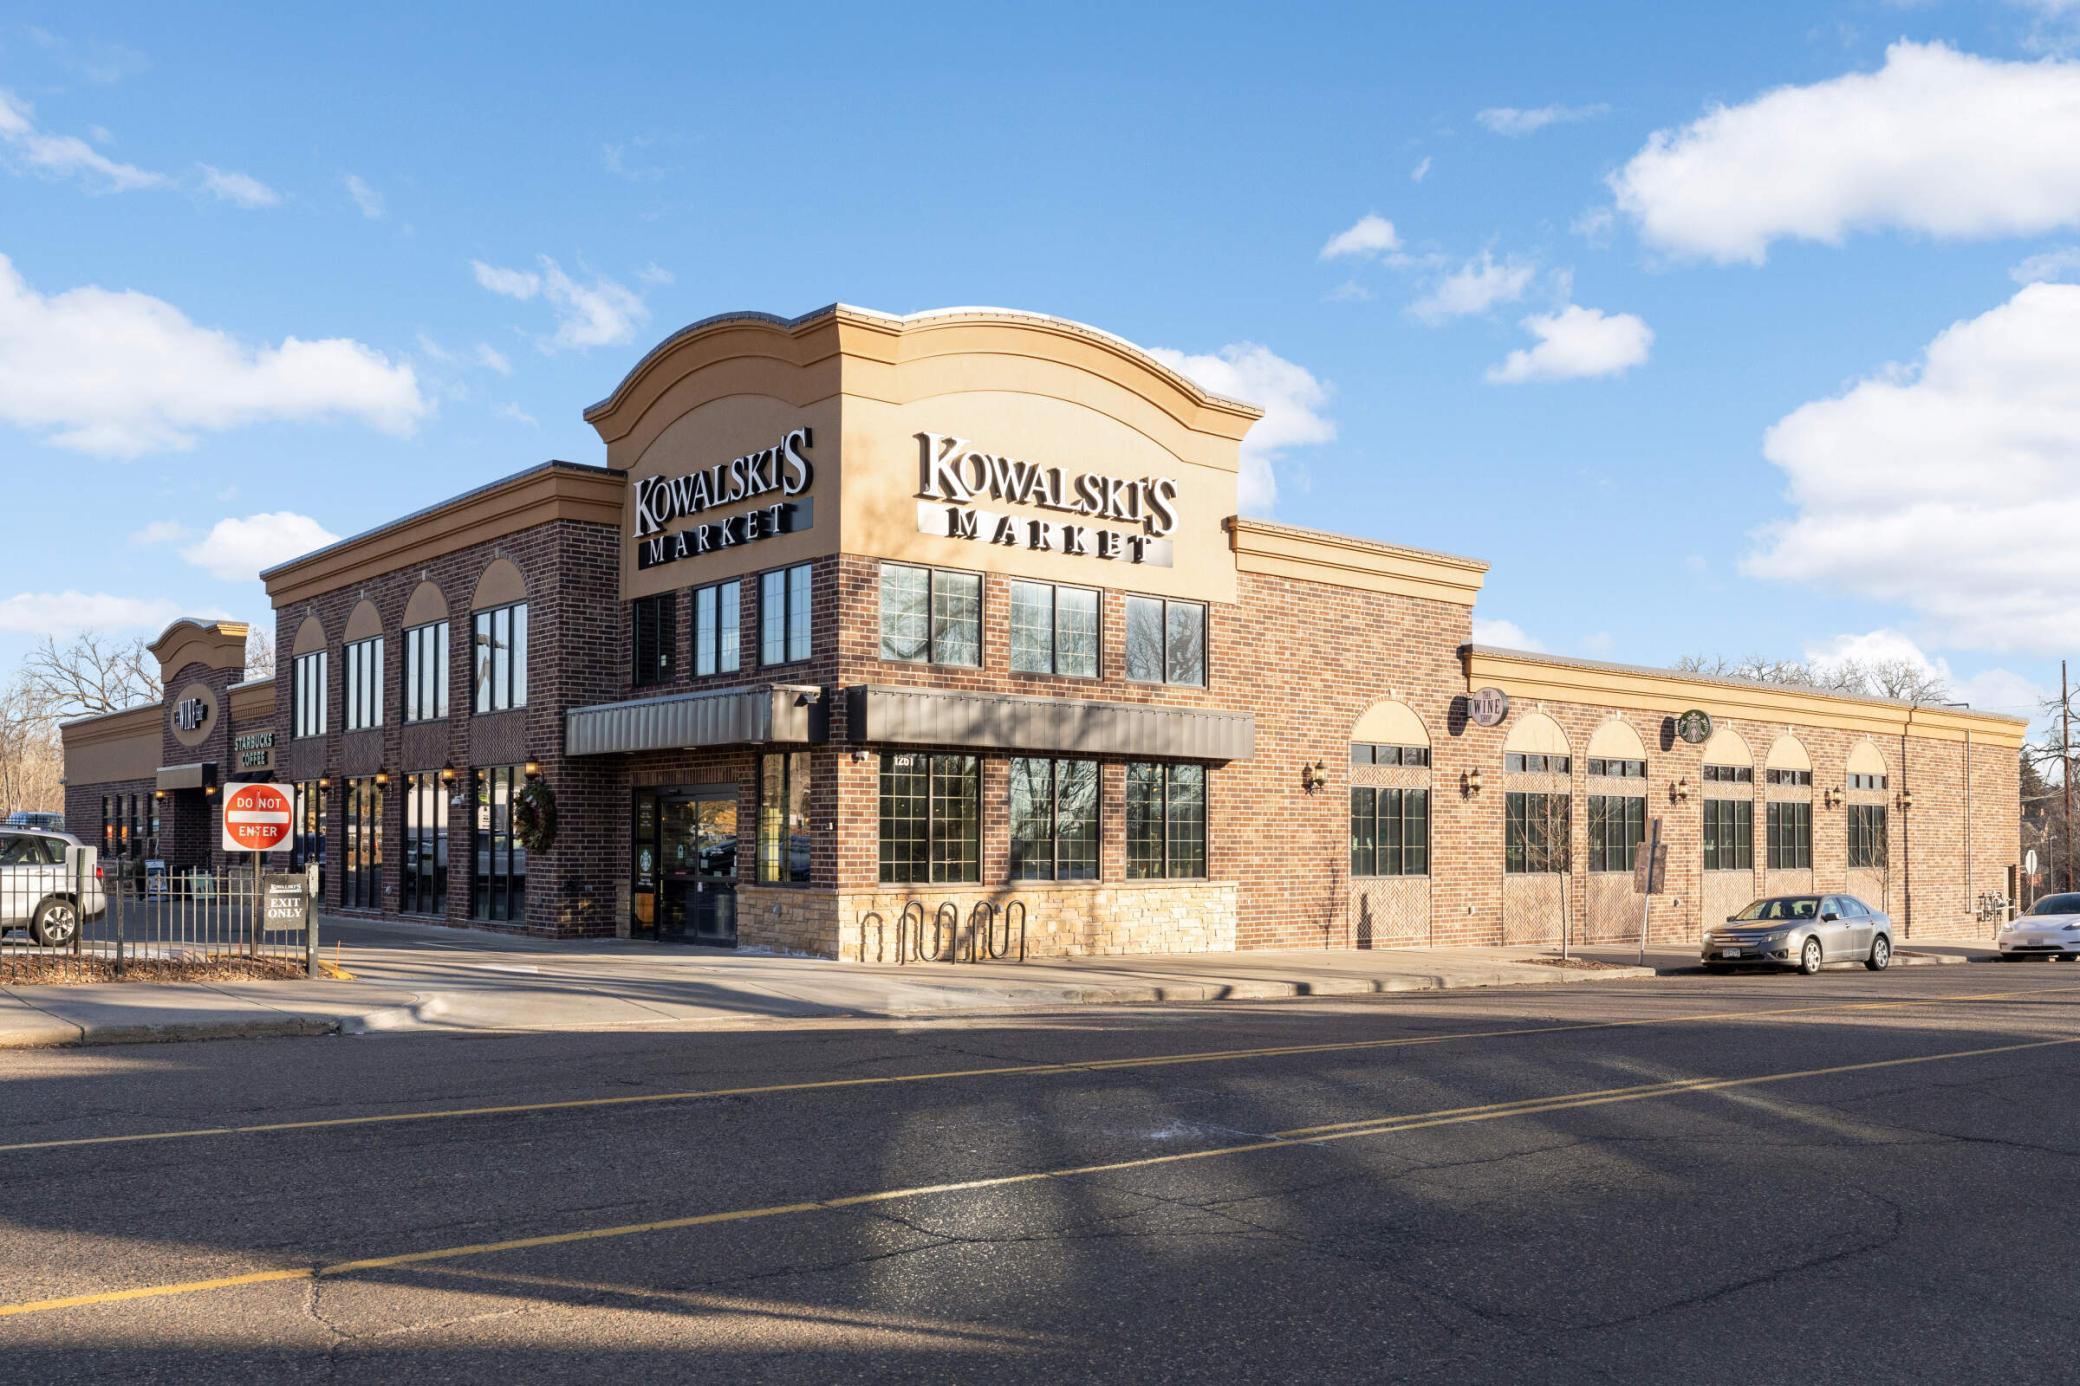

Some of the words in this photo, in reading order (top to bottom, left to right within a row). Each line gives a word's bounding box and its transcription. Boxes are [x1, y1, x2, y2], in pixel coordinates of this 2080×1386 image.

[632, 427, 811, 538] KOWALSKI'S
[914, 431, 1179, 538] KOWALSKI'S
[648, 502, 784, 564] MARKET
[948, 507, 1152, 563] MARKET
[1473, 699, 1500, 714] WINE
[234, 732, 273, 752] STARBUCKS
[242, 751, 266, 768] COFFEE
[236, 797, 253, 809] DO
[258, 798, 282, 809] NOT
[239, 826, 278, 837] ENTER
[270, 897, 301, 908] EXIT
[268, 908, 303, 919] ONLY
